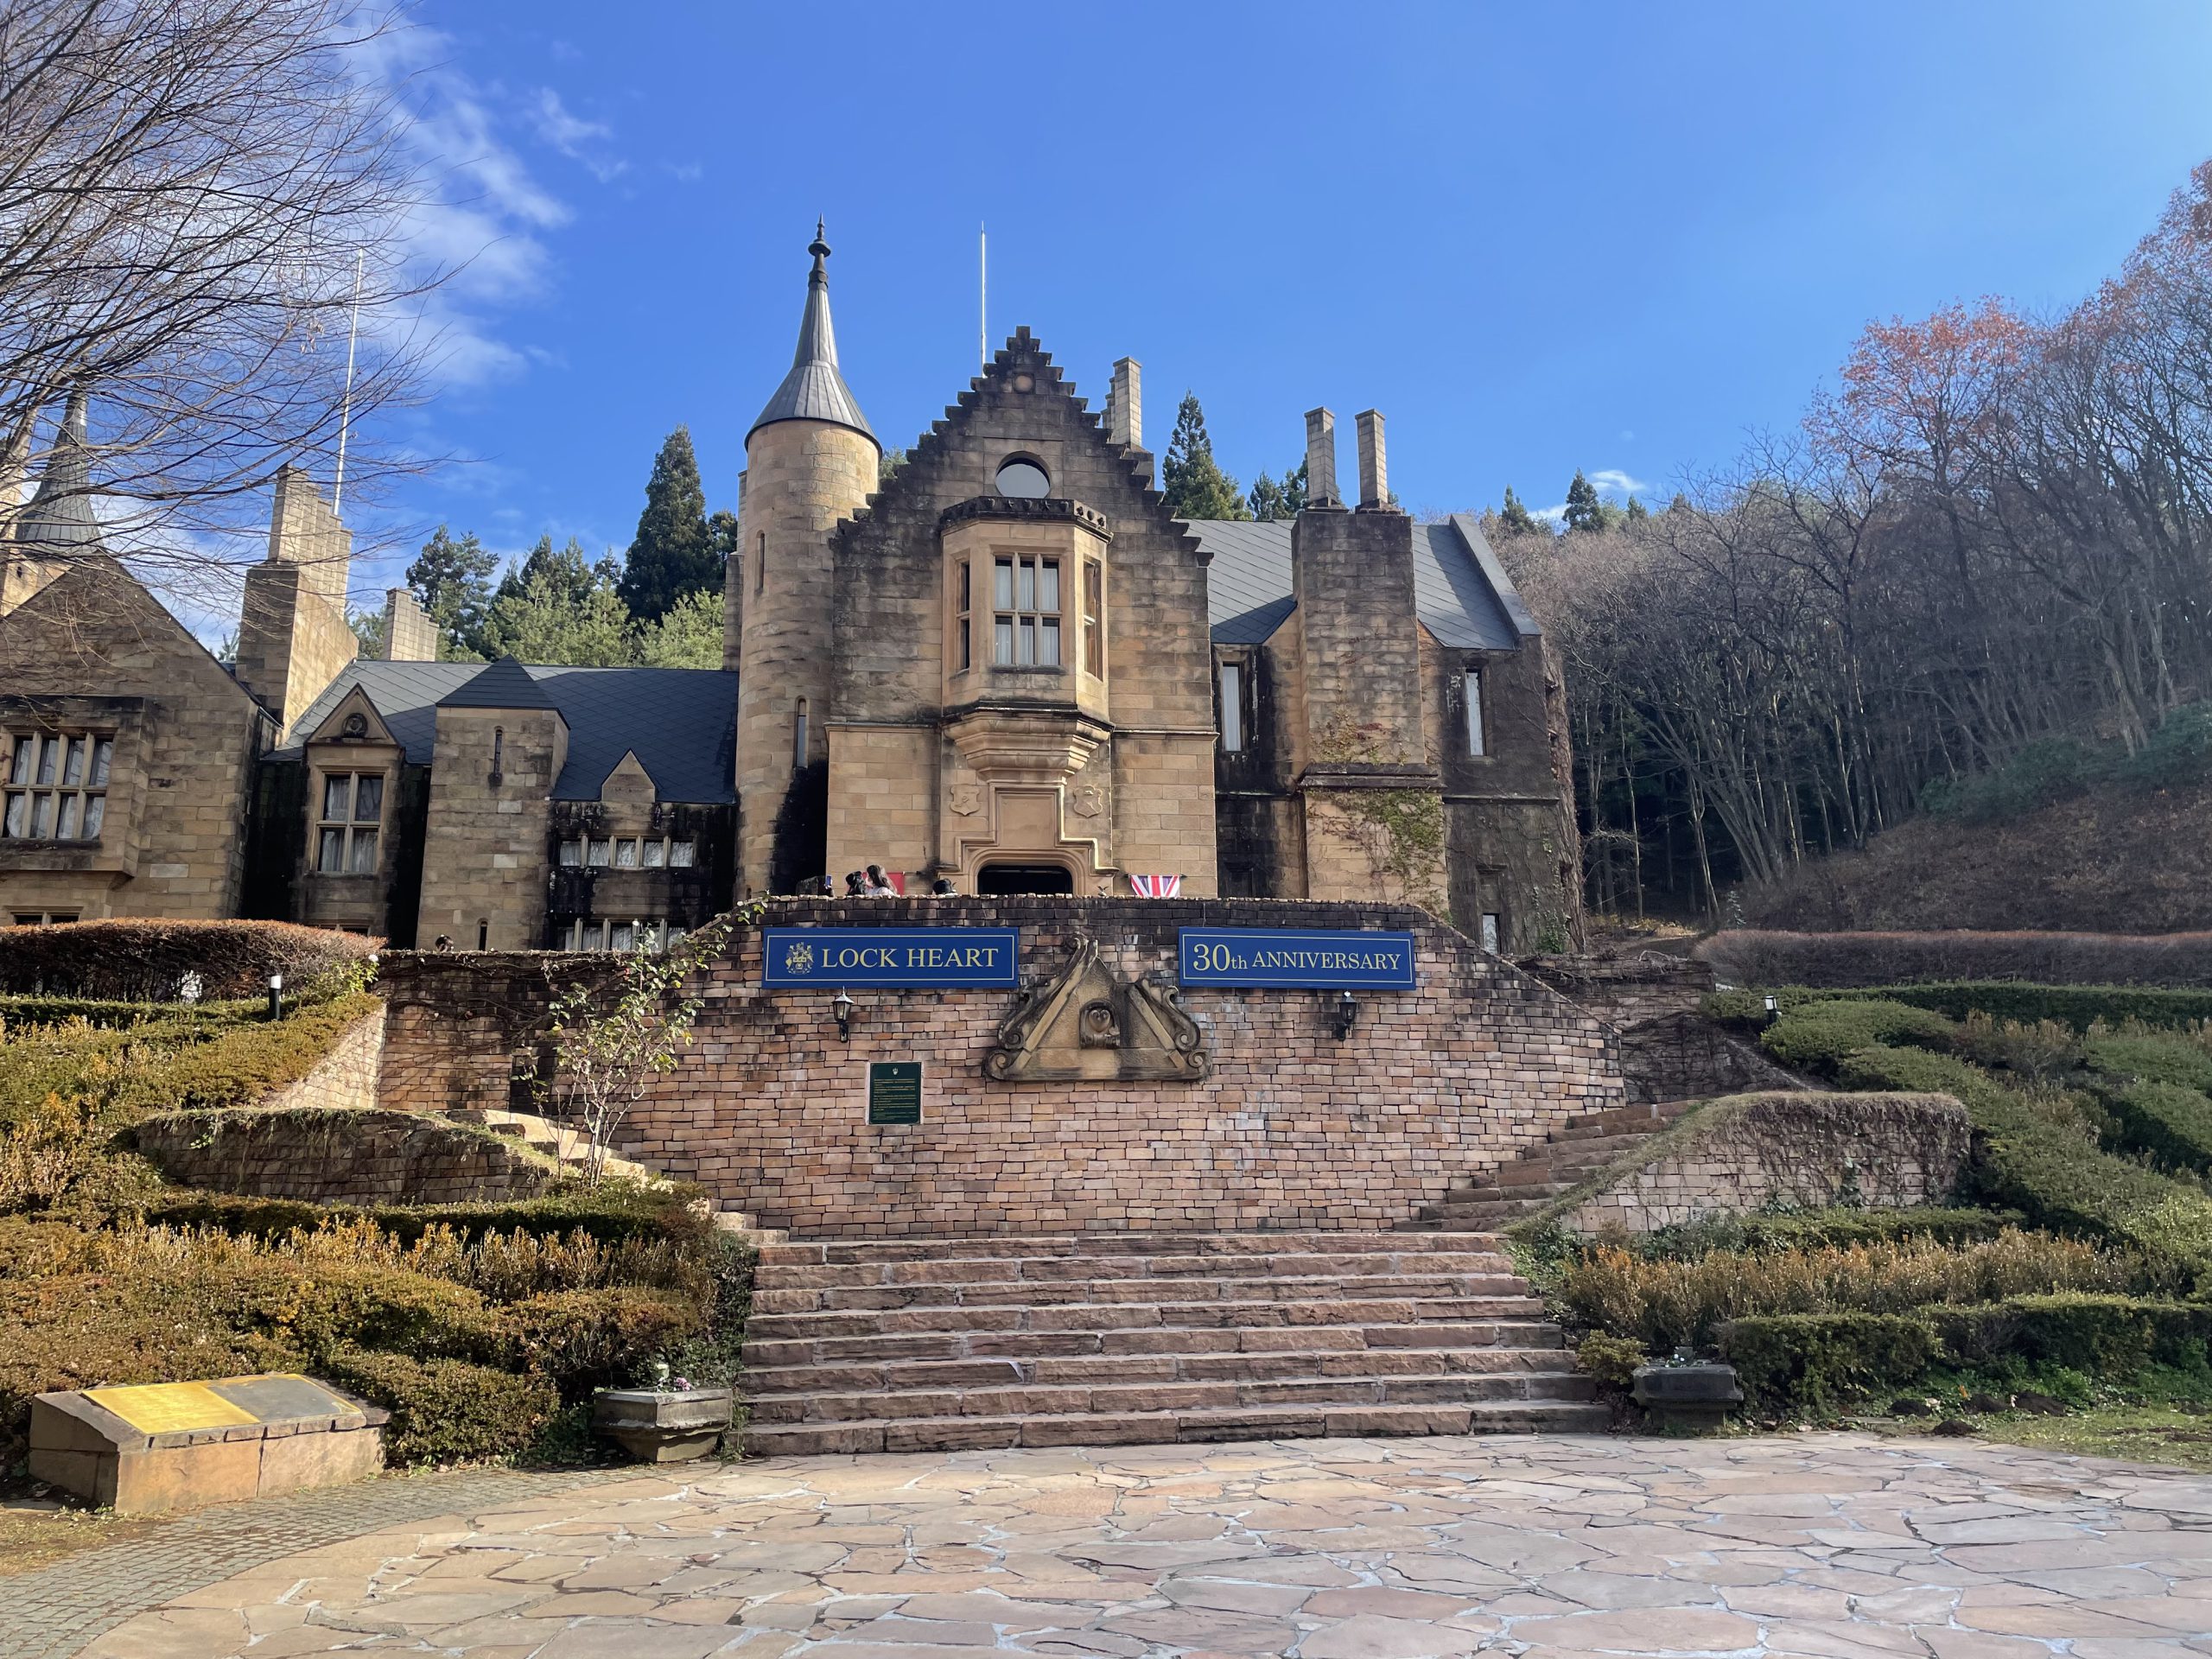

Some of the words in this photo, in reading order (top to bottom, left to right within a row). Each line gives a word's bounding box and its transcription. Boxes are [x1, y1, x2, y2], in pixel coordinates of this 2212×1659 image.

[822, 948, 899, 968] LOCK
[906, 948, 999, 968] HEART
[1193, 944, 1249, 971] 30th
[1252, 951, 1402, 970] ANNIVERSARY
